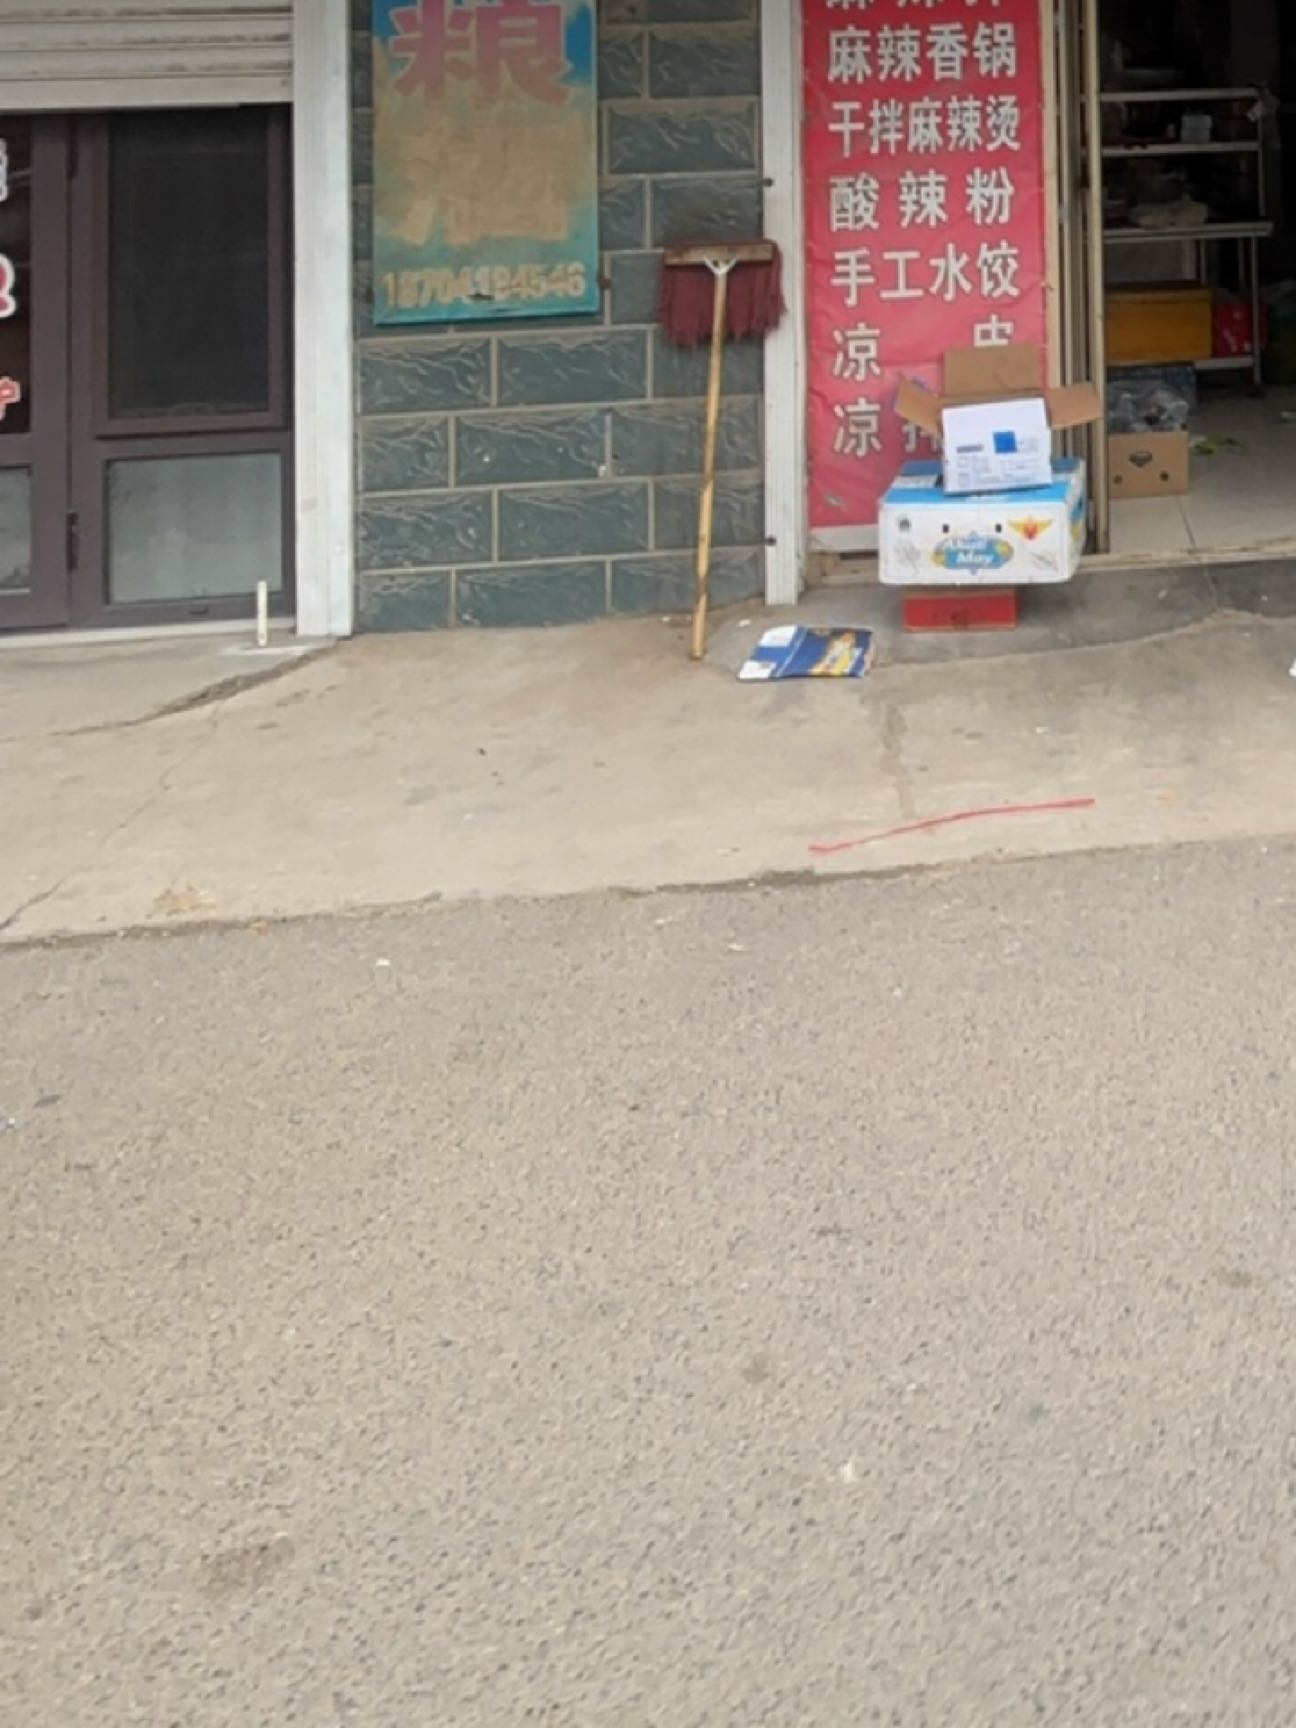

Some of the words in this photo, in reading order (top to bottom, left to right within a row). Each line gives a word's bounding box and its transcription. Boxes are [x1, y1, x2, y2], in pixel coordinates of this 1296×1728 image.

[827, 22, 1017, 84] 麻辣香锅
[828, 94, 1021, 158] 干拌麻辣烫
[829, 168, 1015, 232] 酸辣粉
[829, 240, 1021, 307] 手工水饺
